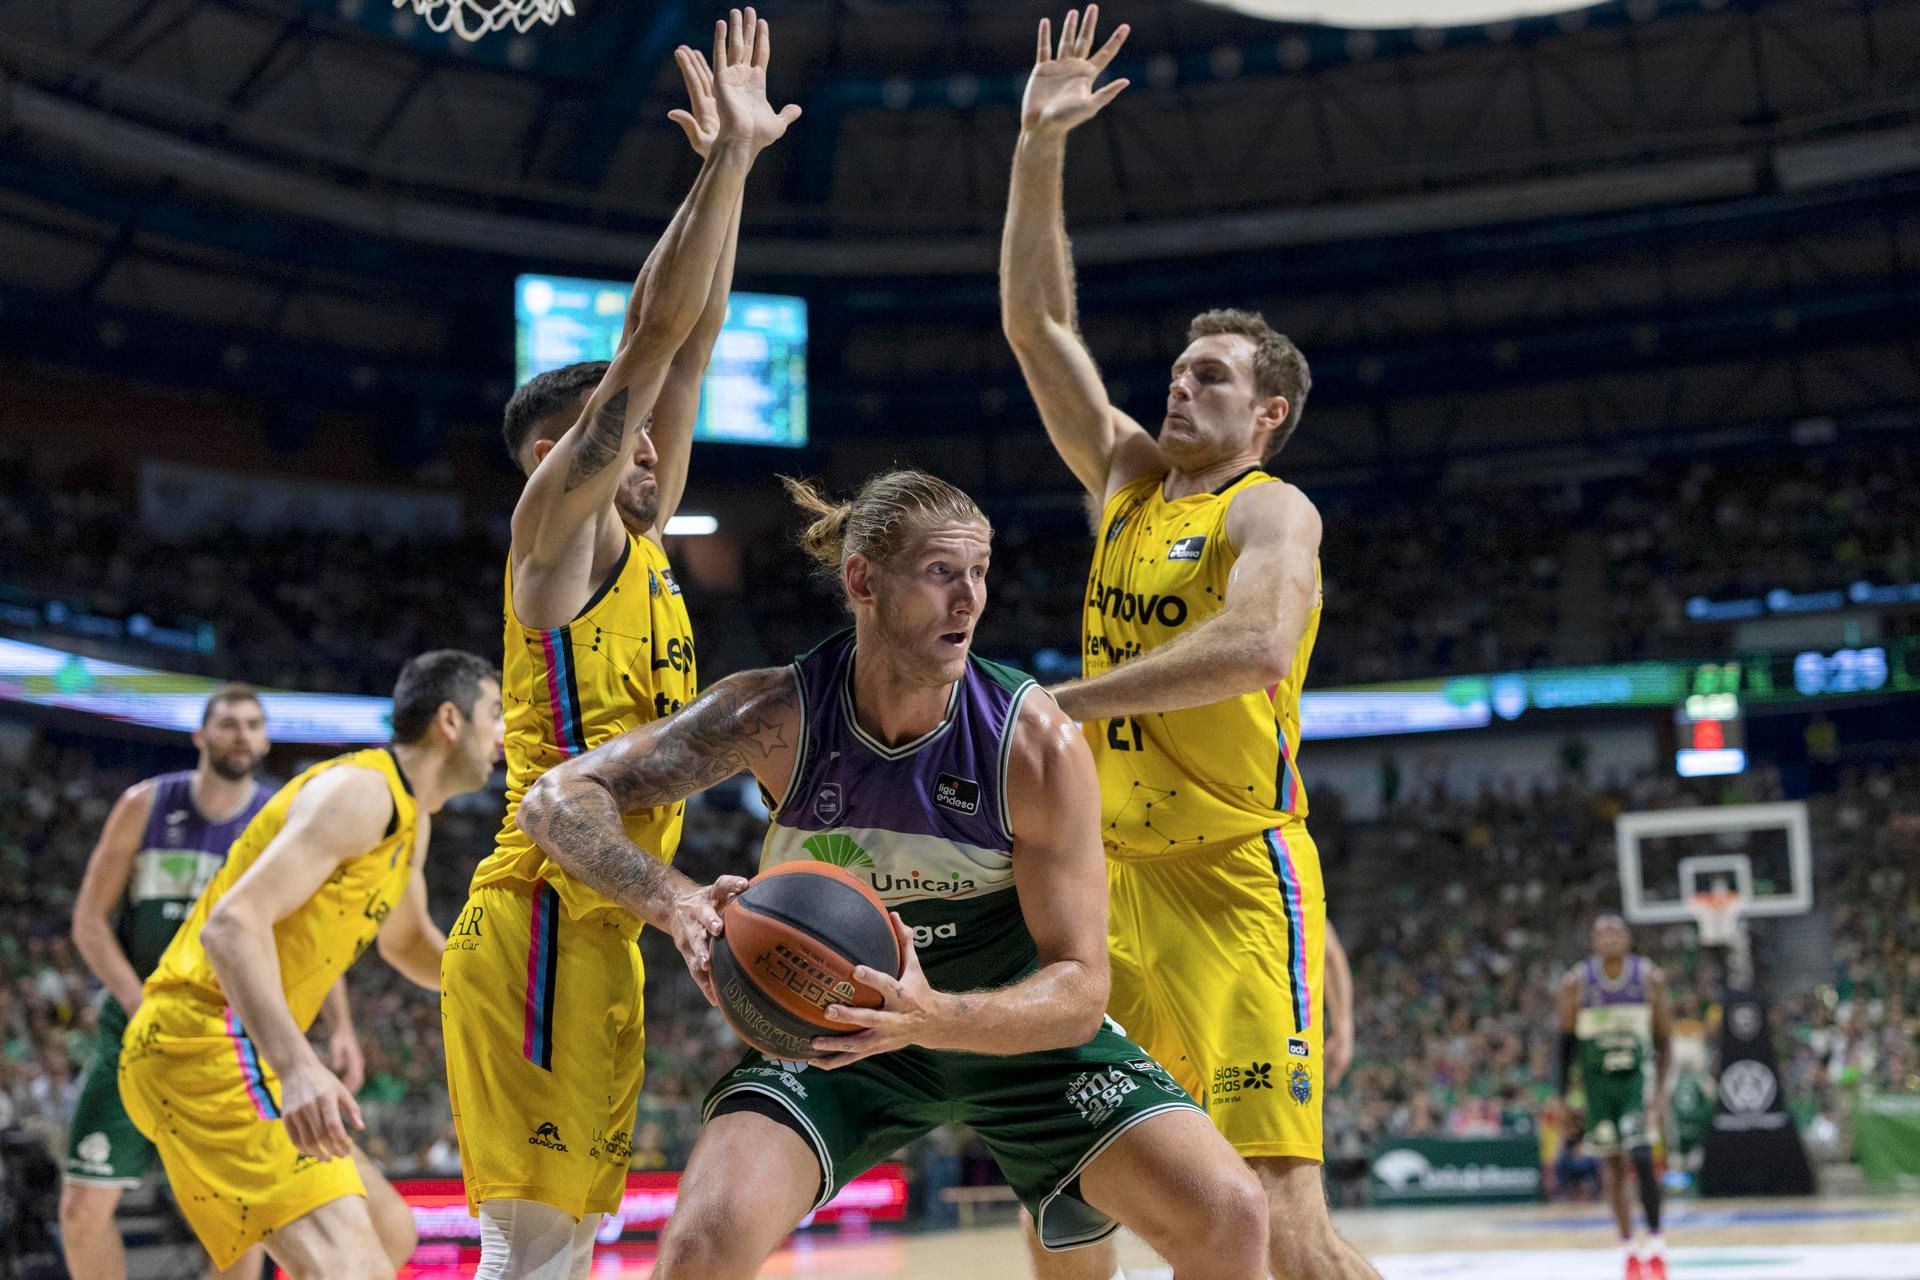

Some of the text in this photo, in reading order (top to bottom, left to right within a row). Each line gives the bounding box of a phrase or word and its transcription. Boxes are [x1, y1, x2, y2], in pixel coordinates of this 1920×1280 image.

[936, 793, 974, 810] endesa
[871, 870, 975, 893] Unicaja
[723, 975, 813, 1052] PALDING
[1212, 1080, 1241, 1094] arias
